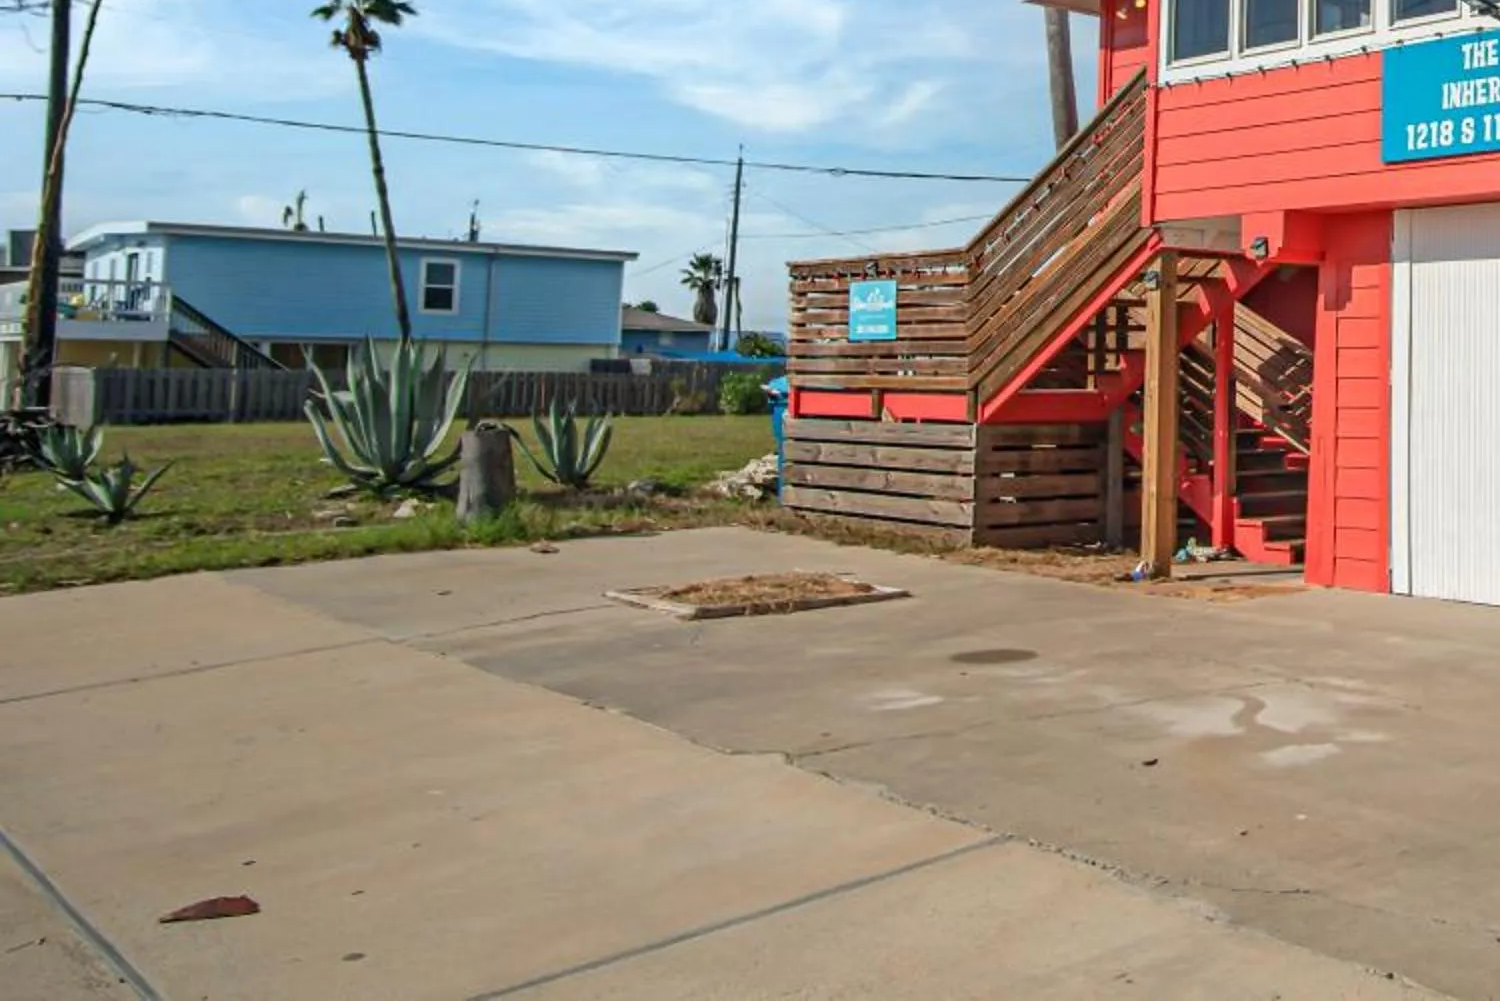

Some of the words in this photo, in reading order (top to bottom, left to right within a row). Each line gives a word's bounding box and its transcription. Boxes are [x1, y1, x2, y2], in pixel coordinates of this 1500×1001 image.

[1462, 38, 1499, 70] THE
[1406, 118, 1454, 151] 1218
[1460, 117, 1475, 144] S
